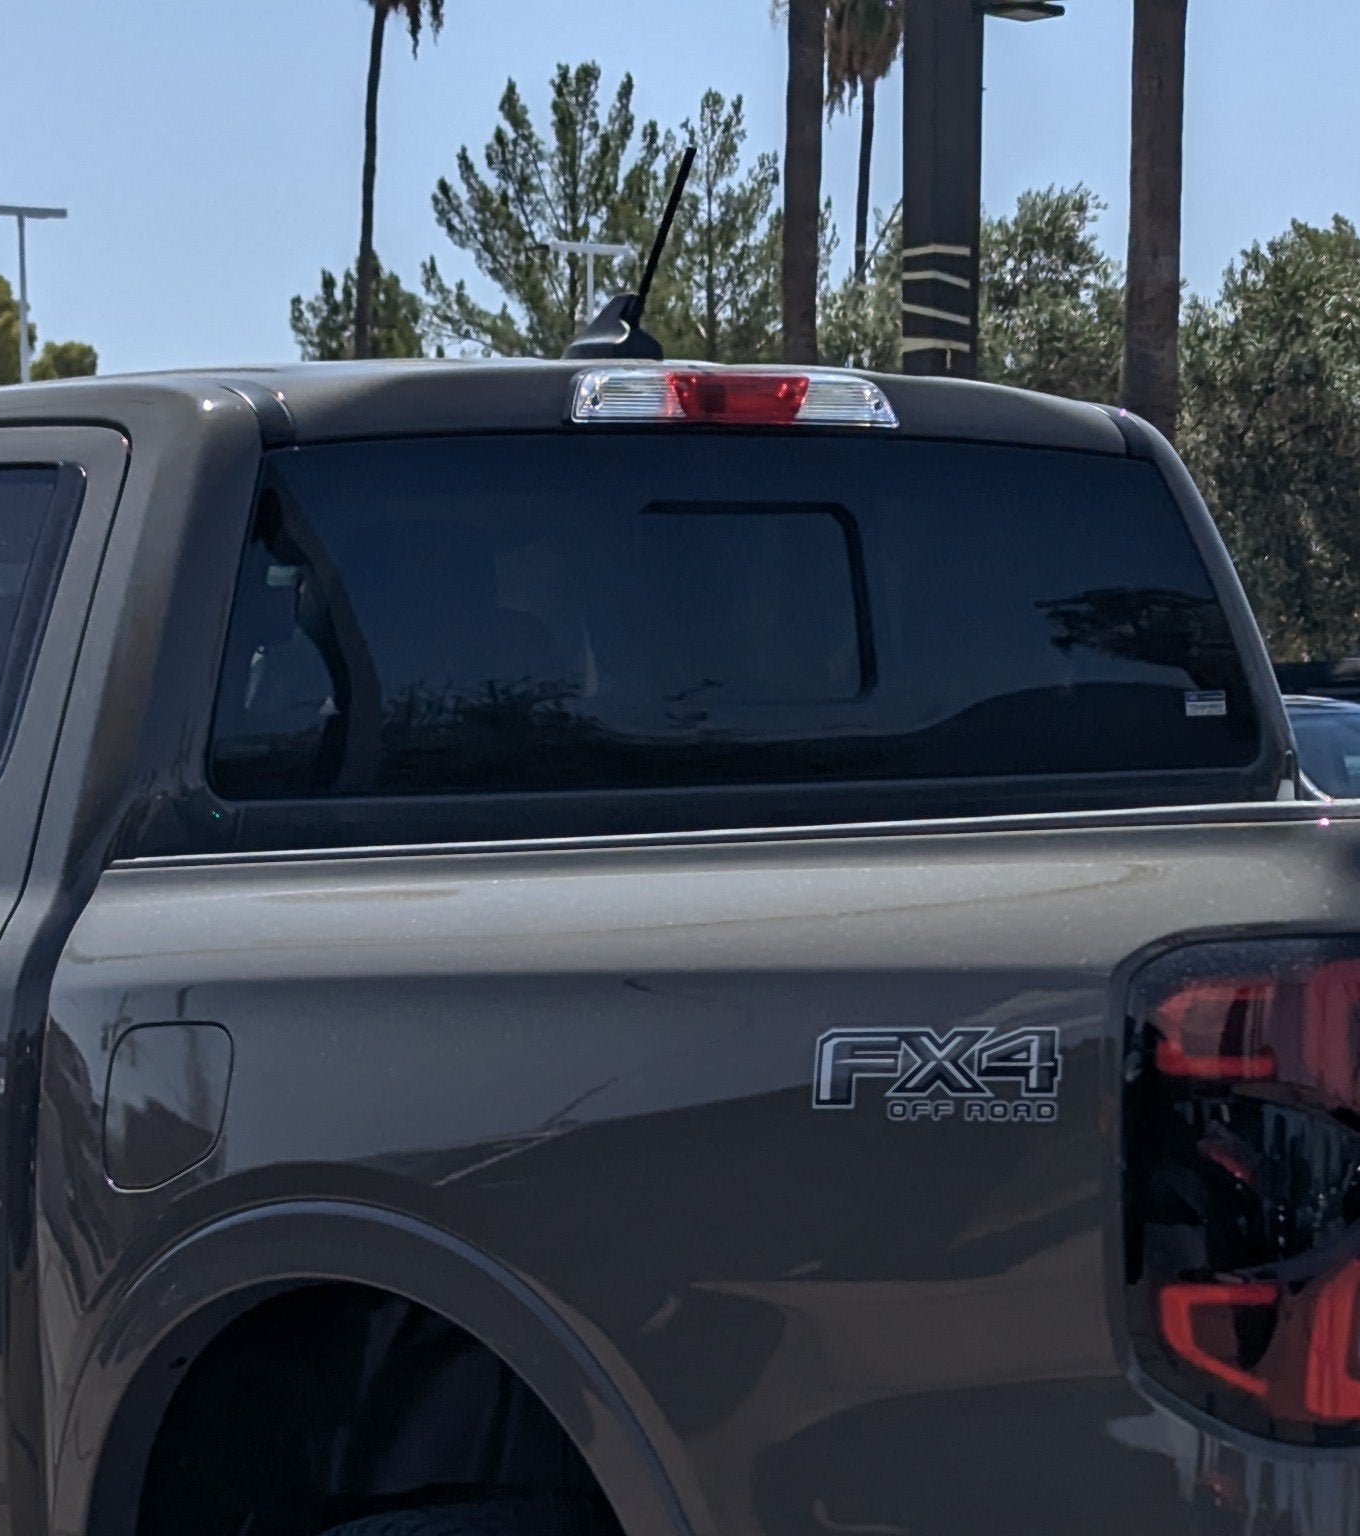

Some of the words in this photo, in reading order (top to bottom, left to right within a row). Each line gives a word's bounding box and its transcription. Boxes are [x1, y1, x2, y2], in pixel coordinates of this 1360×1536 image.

[812, 1026, 1062, 1110] FX4
[887, 1099, 954, 1122] OFF
[963, 1099, 1058, 1122] ROAD
